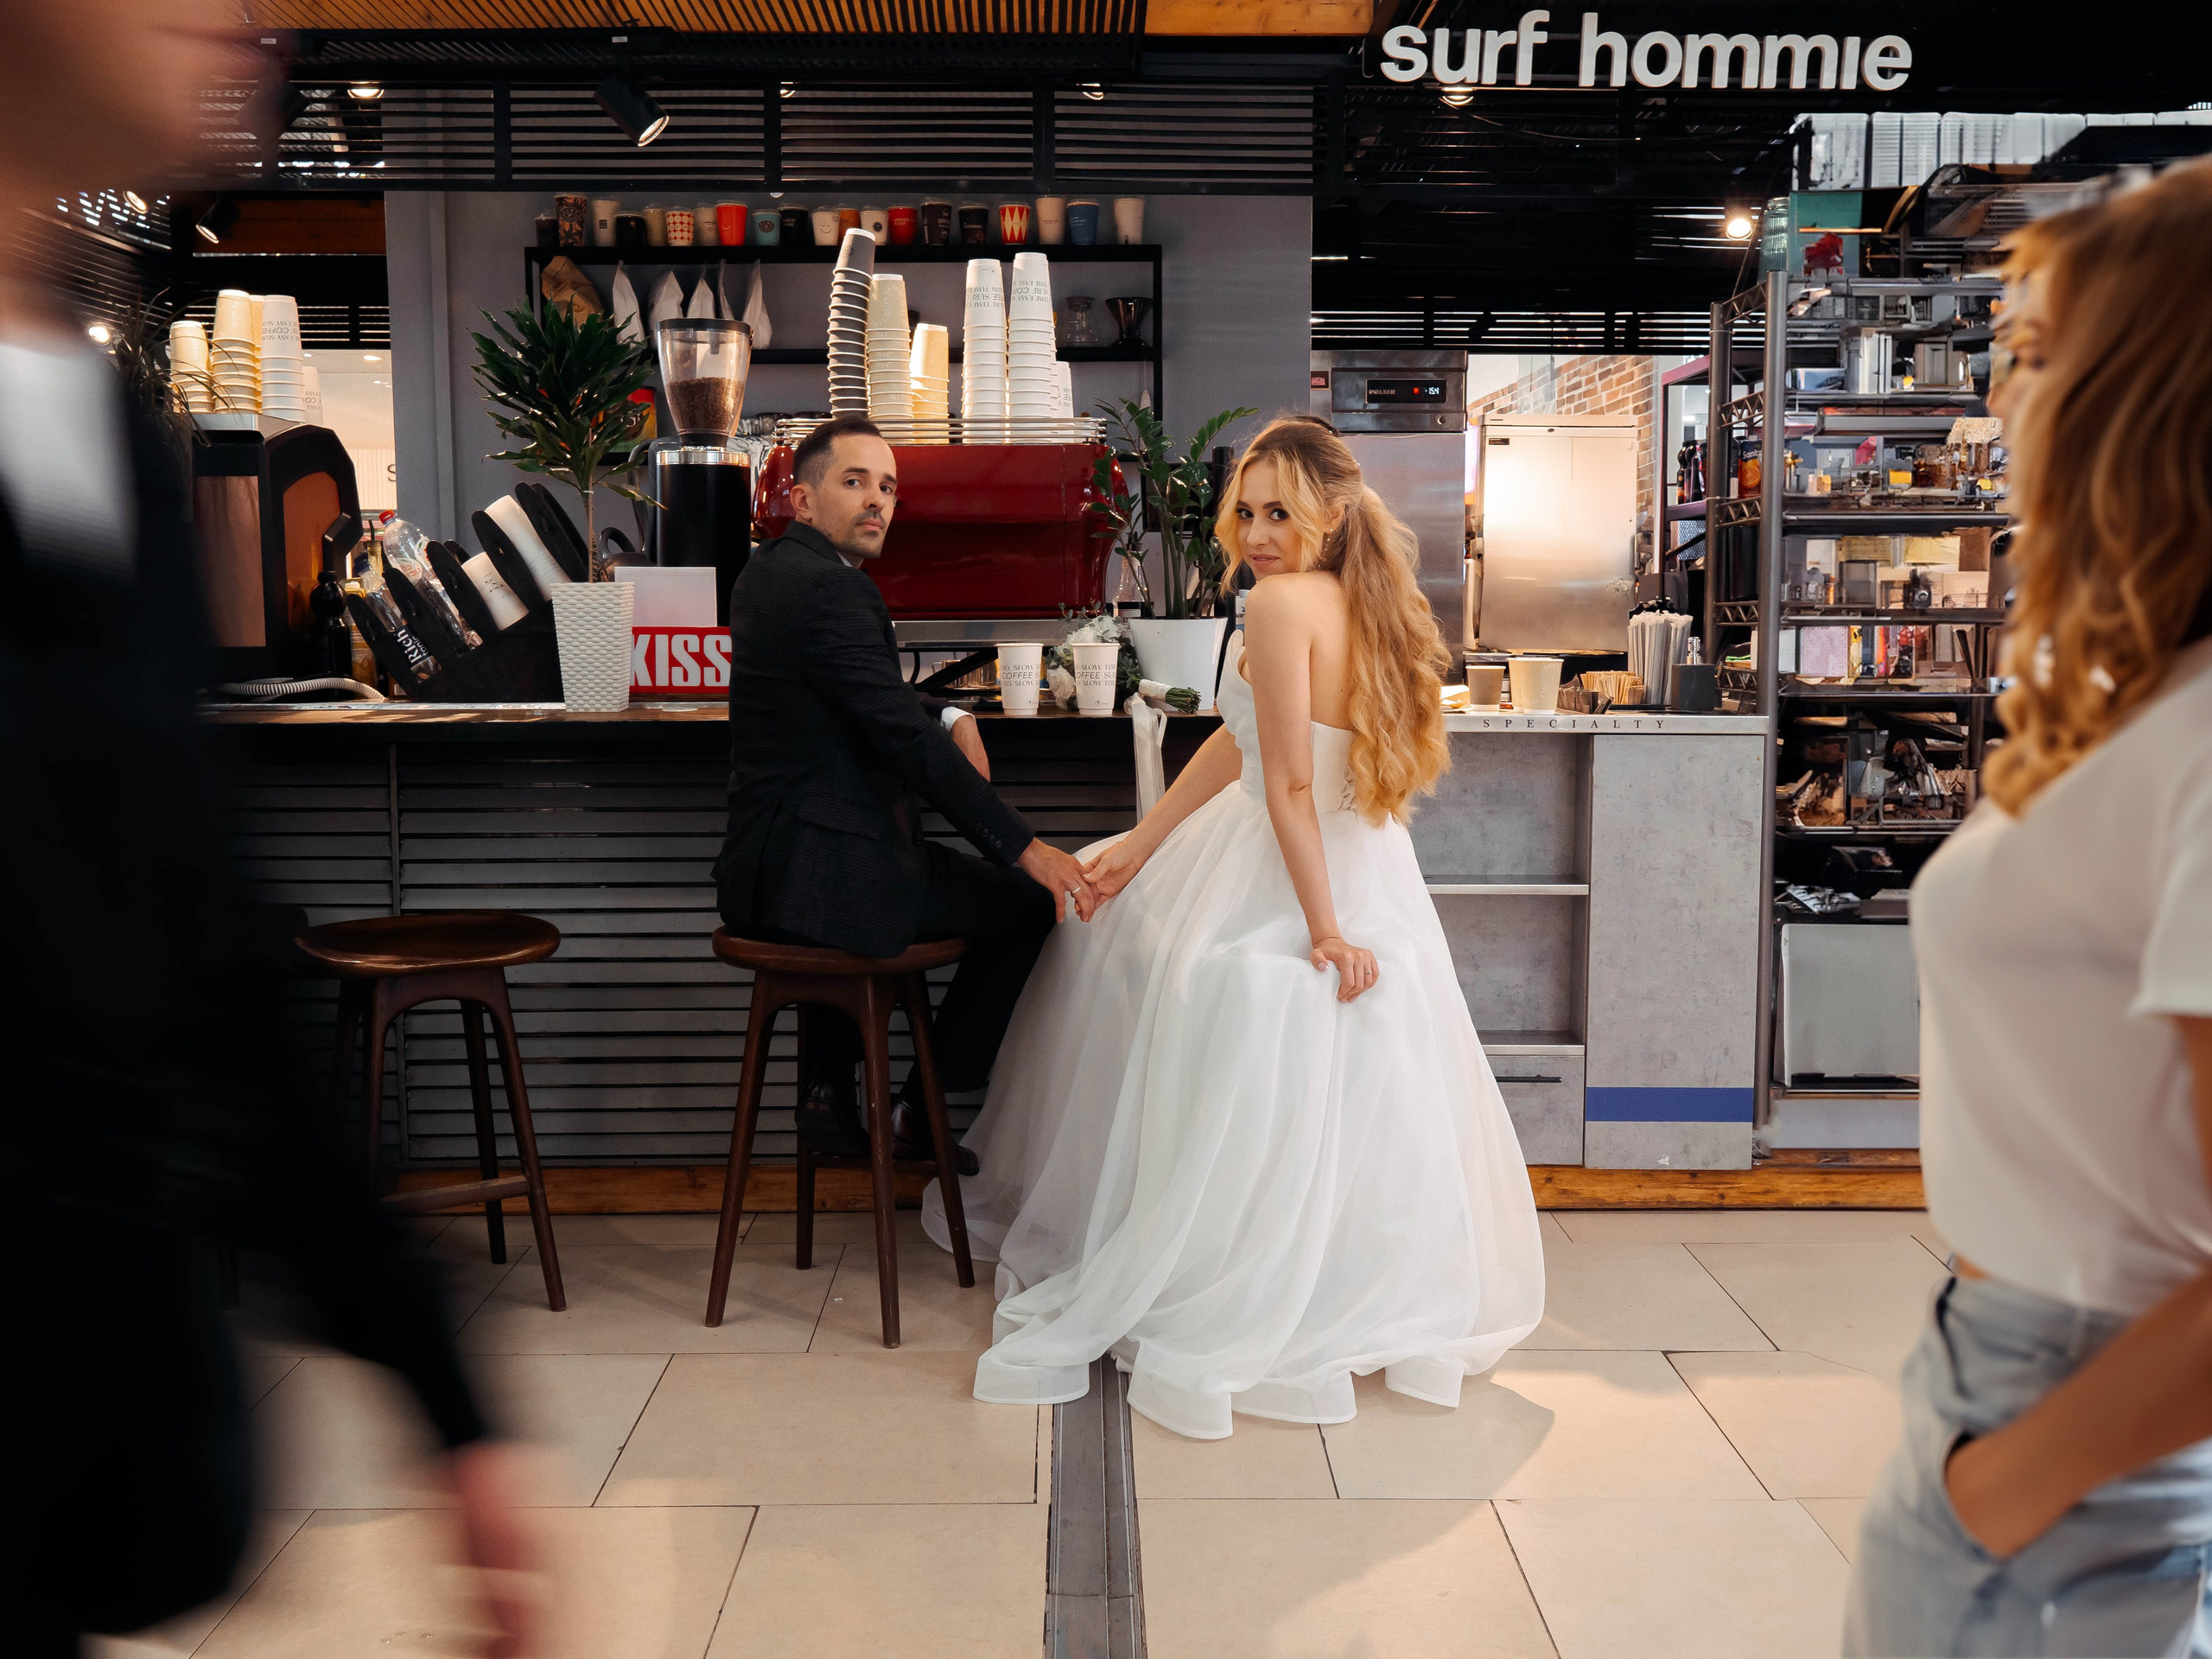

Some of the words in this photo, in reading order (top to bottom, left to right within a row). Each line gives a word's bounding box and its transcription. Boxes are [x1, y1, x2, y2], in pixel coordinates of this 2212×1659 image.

[1380, 10, 1550, 86] surf
[397, 628, 423, 664] Rich
[631, 634, 733, 687] KISS
[1002, 671, 1033, 680] COFFEE
[1483, 719, 1664, 728] SPECIALTY
